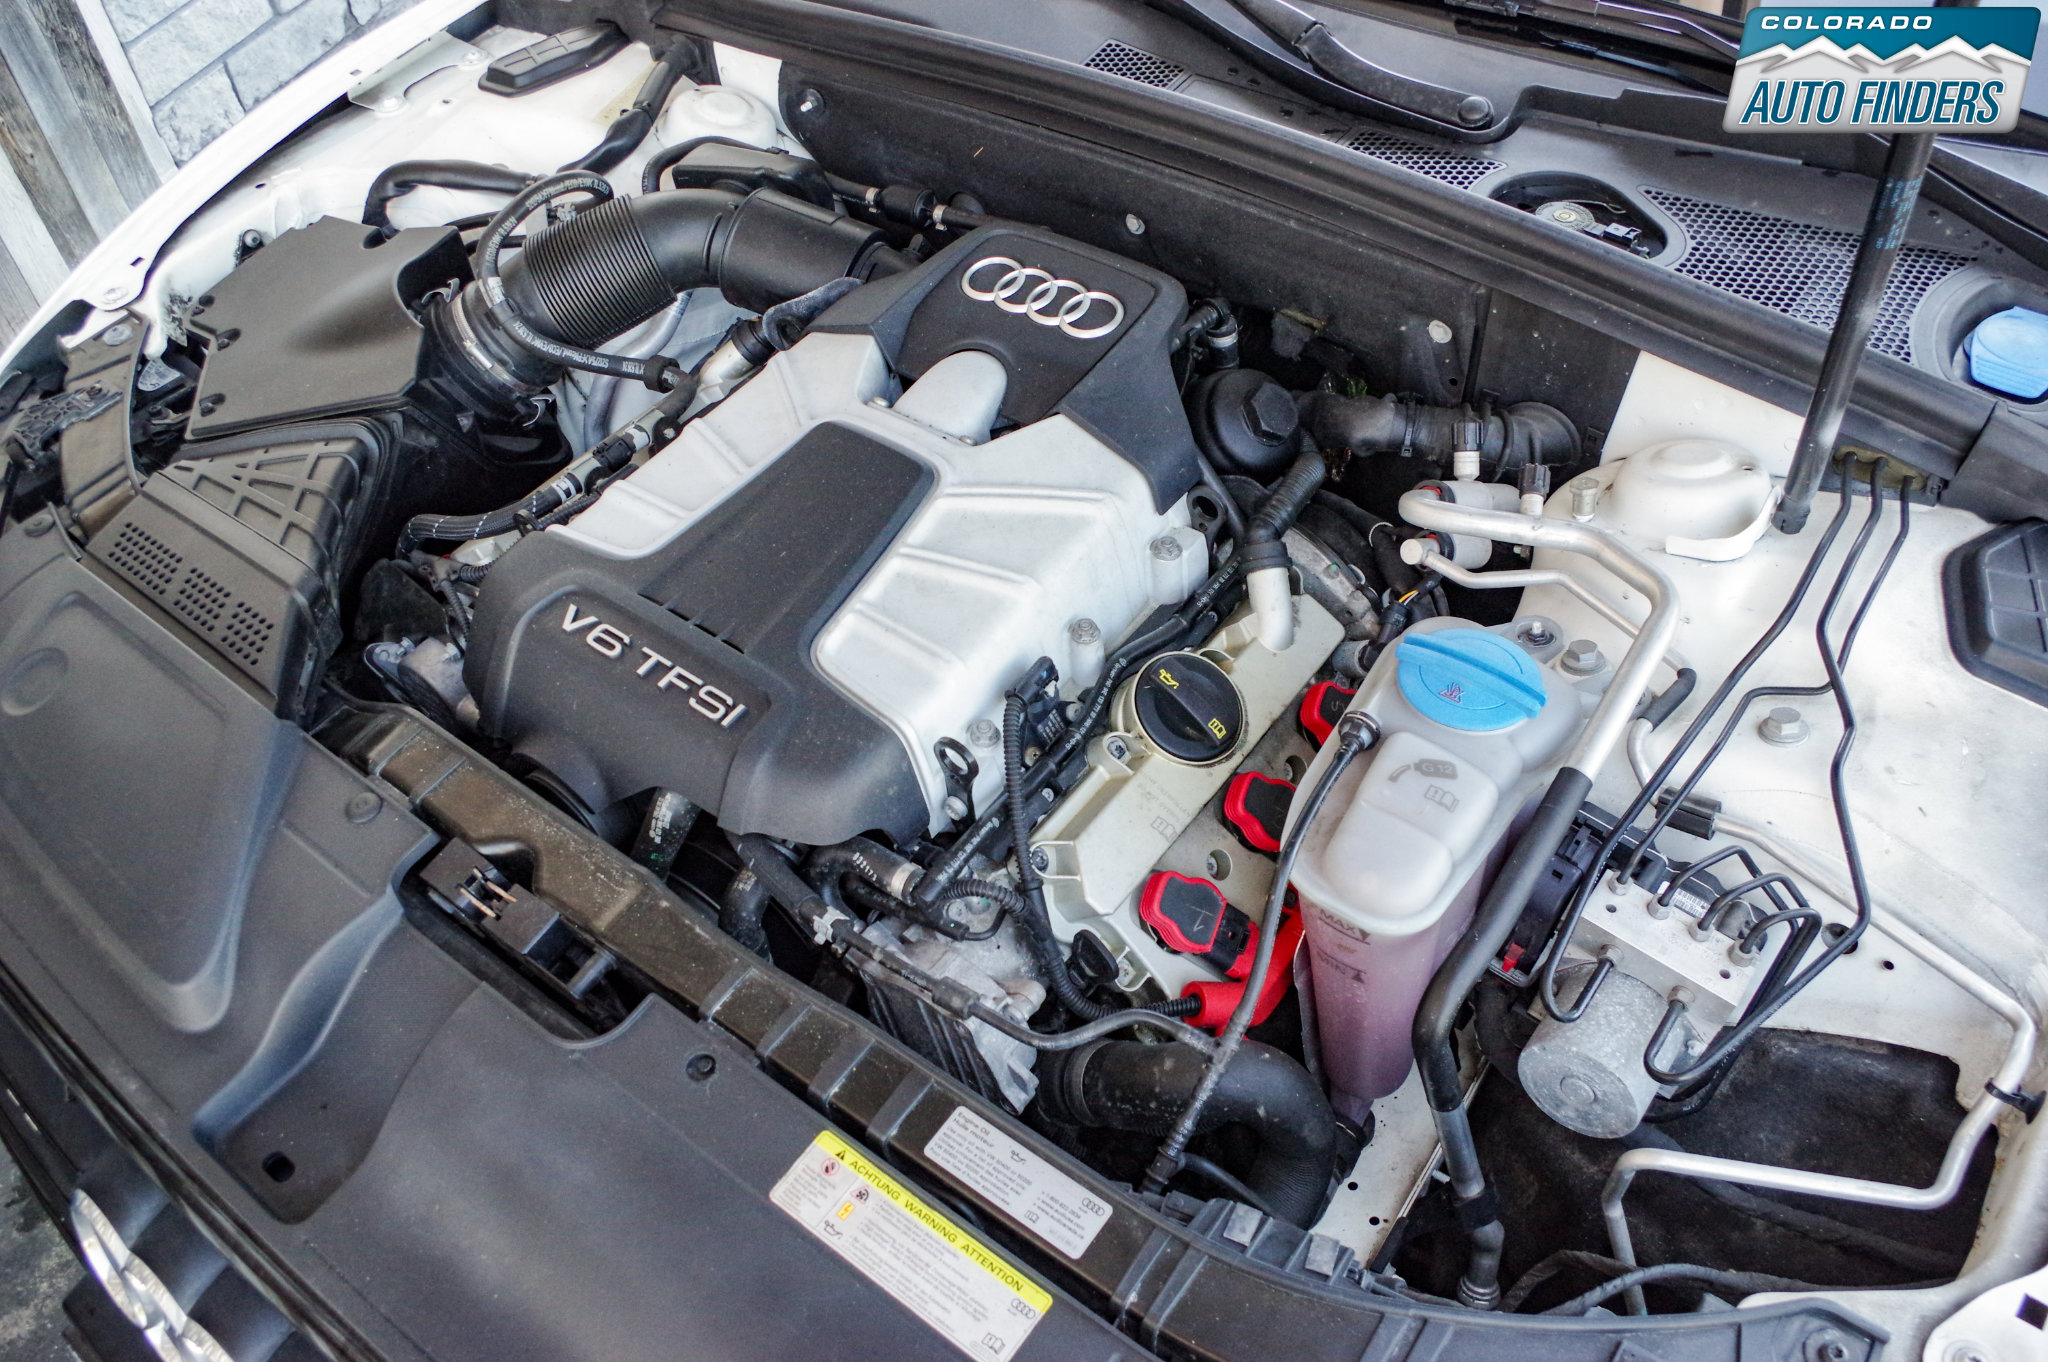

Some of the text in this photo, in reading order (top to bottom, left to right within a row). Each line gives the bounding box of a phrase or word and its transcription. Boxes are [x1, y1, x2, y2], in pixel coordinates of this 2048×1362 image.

[562, 603, 748, 728] V6 TFSI
[1320, 908, 1356, 934] MAX
[956, 1111, 990, 1136] Engine Oil
[849, 1159, 902, 1201] ACHTUNG
[904, 1199, 959, 1243] WARNING
[961, 1241, 1025, 1291] ATTENTION
